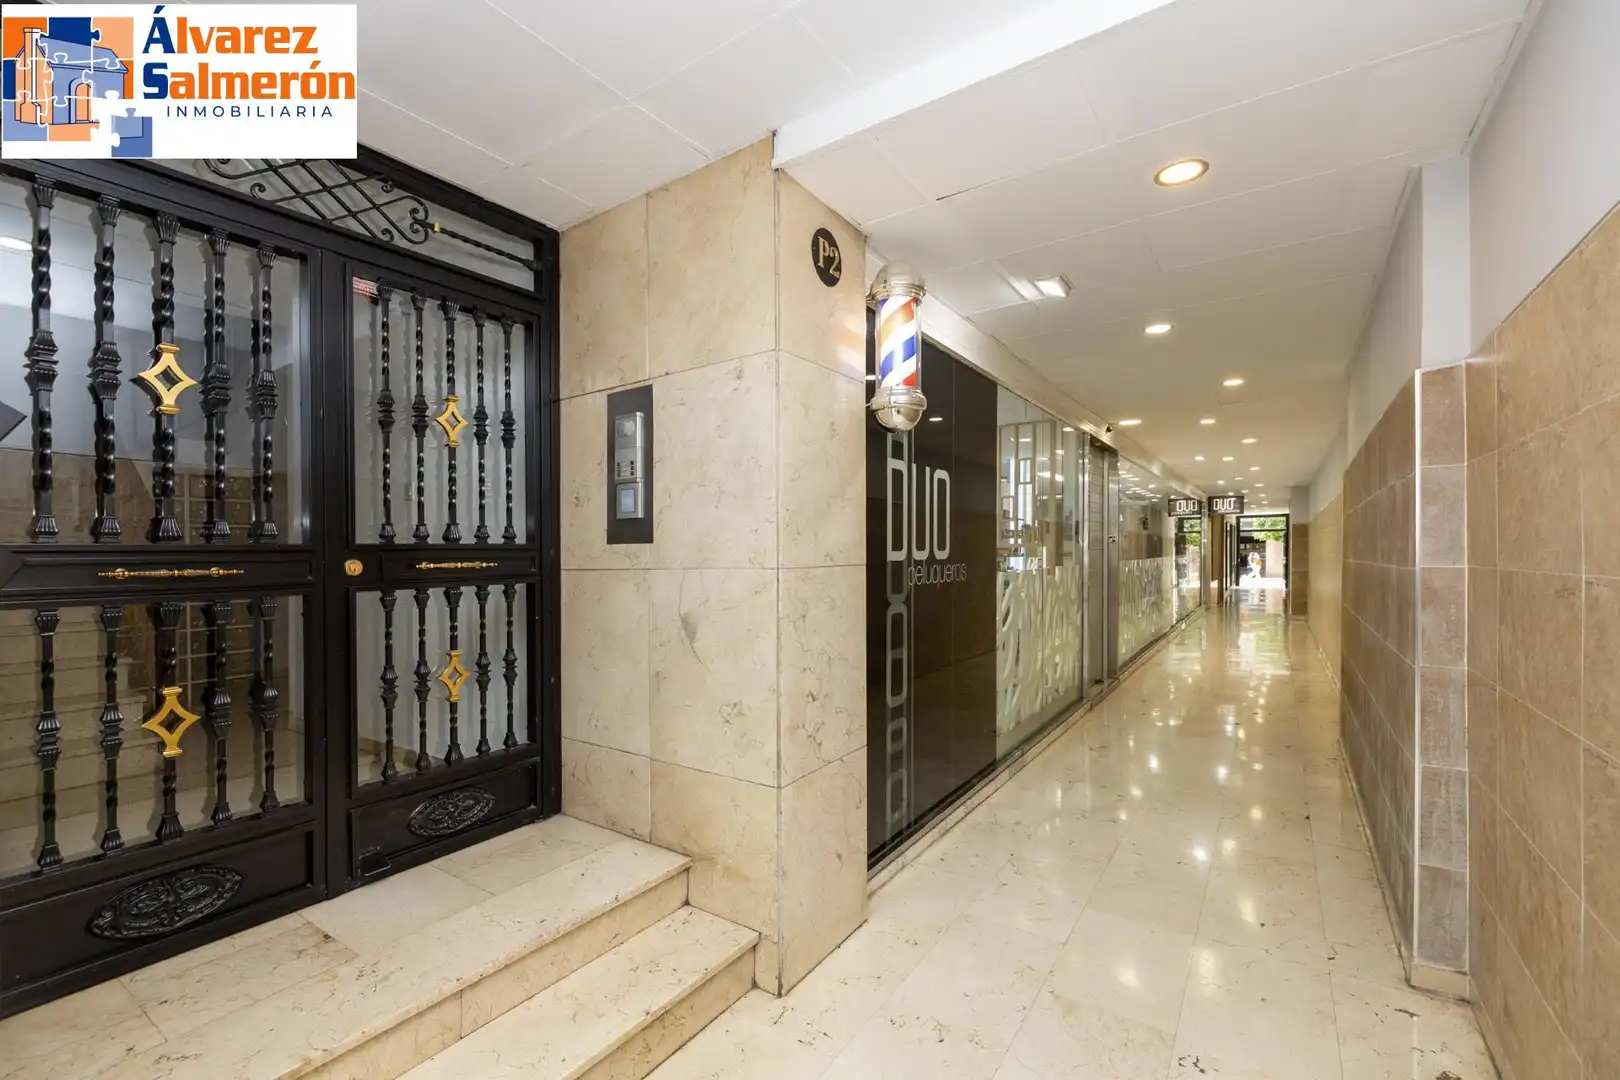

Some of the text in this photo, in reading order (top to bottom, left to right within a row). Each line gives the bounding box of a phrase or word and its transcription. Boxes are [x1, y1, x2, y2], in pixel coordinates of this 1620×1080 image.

[817, 236, 841, 279] P2
[1213, 497, 1237, 511] DUO
[908, 560, 968, 590] peluqueros
